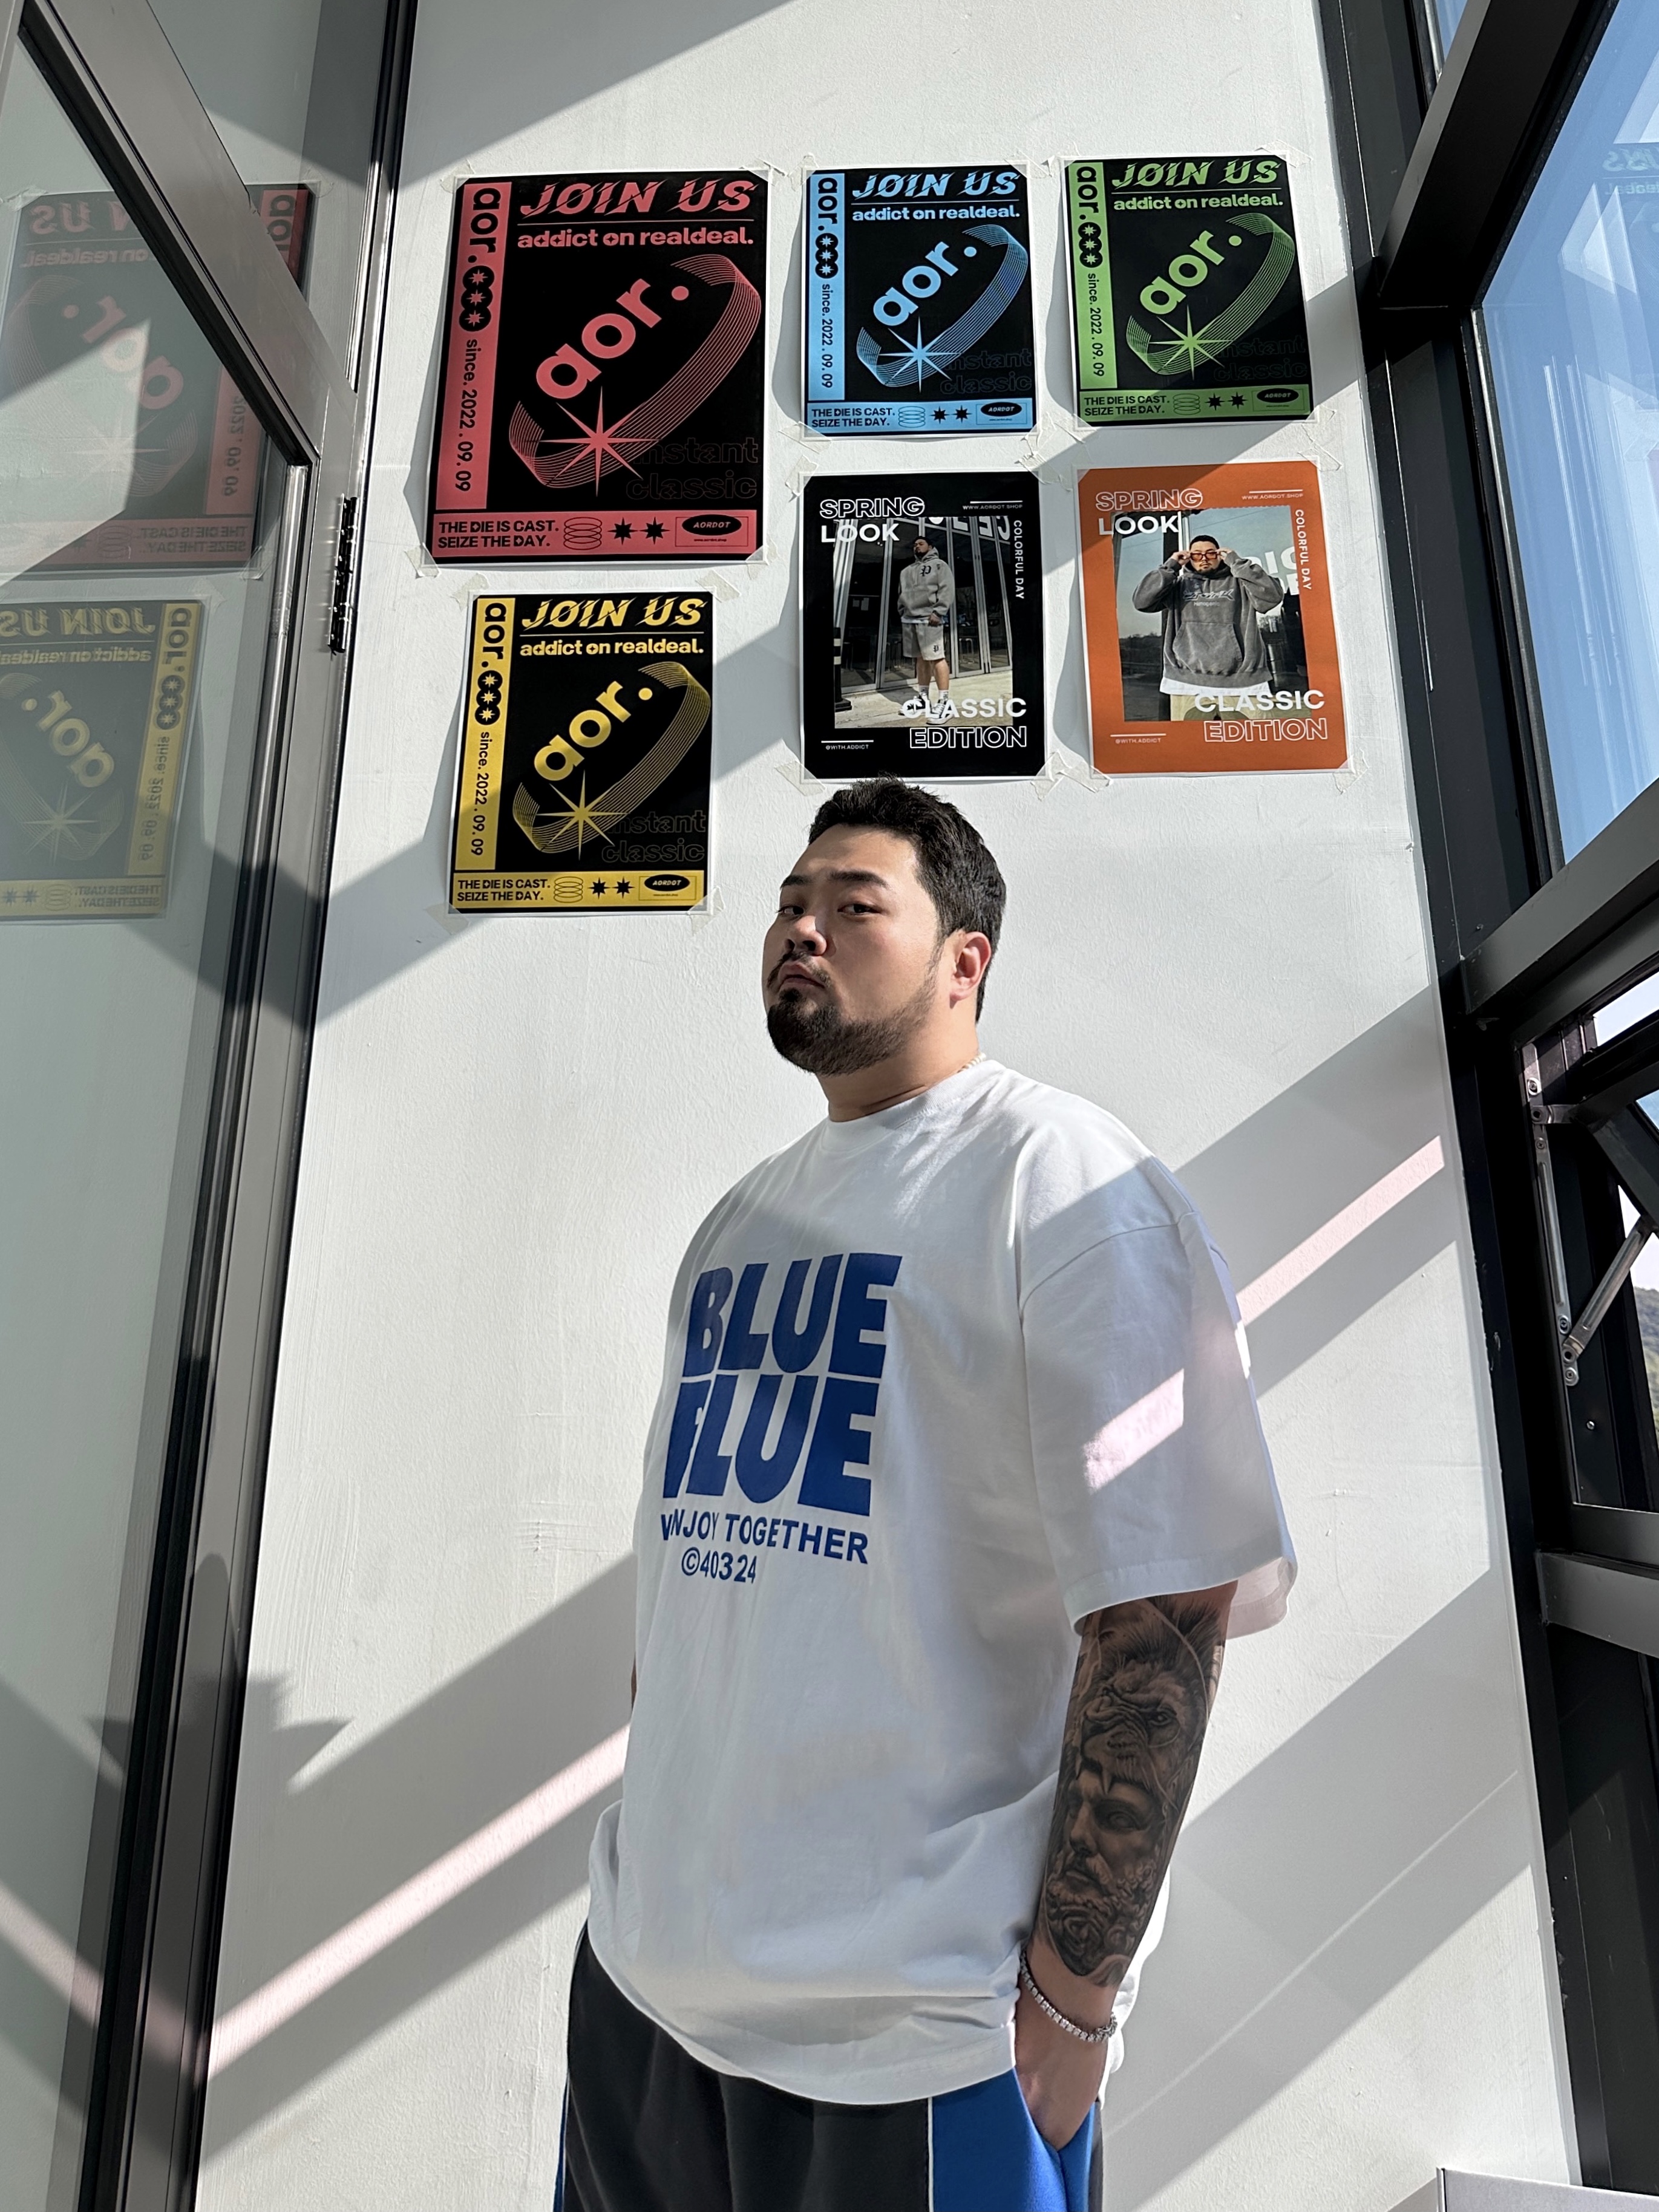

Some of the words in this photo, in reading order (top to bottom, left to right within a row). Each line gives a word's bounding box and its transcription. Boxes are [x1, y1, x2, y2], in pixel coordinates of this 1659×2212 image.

[852, 172, 955, 200] JOIN
[957, 171, 1021, 197] US
[1111, 161, 1214, 189] JOIN
[1217, 159, 1281, 184] US
[520, 178, 666, 218] JOIN
[666, 179, 759, 213] US
[817, 177, 838, 231] aor.
[1076, 166, 1099, 220] aor.
[1114, 196, 1172, 210] addict
[1174, 198, 1197, 209] on
[1202, 193, 1283, 207] realdeal.
[852, 207, 909, 221] addict
[912, 209, 935, 220] on
[939, 205, 1020, 219] realdeal.
[468, 188, 502, 264] aor.
[517, 229, 598, 248] addict
[603, 232, 634, 246] on
[640, 227, 754, 245] realdeal.
[873, 241, 977, 326] aor.
[1140, 230, 1242, 315] aor.
[822, 284, 830, 316] since.
[1088, 273, 1098, 306] since.
[536, 278, 689, 399] aor.
[463, 339, 482, 385] since.
[1084, 397, 1105, 405] THE
[1107, 396, 1124, 405] DIE
[1137, 395, 1170, 403] CAST.
[1084, 406, 1113, 416] SEIZE
[1116, 406, 1136, 414] THE
[1139, 405, 1165, 414] DAY.
[812, 419, 840, 427] SEIZE
[842, 418, 862, 426] THE
[865, 417, 890, 426] DAY.
[633, 437, 759, 465] nstant
[819, 497, 925, 519] SPRING
[1095, 489, 1203, 511] SPRING
[439, 521, 468, 533] THE
[470, 521, 494, 532] DIE
[497, 520, 511, 532] IS
[513, 520, 559, 532] CAST.
[820, 523, 900, 543] LOOK
[1098, 515, 1179, 536] LOOK
[1295, 509, 1309, 565] COLORFUL
[438, 536, 478, 549] SEIZE
[481, 535, 511, 547] THE
[514, 535, 551, 547] DAY.
[1013, 520, 1024, 575] COLORFUL
[1015, 578, 1025, 599] DAY
[1301, 568, 1312, 590] DAY
[522, 597, 638, 631] JOIN
[634, 596, 708, 627] US
[482, 602, 506, 668] aor.
[520, 640, 583, 656] addict
[586, 642, 610, 655] on
[615, 638, 704, 654] realdeal.
[902, 697, 1027, 719] CLASSIC
[1194, 689, 1325, 713] CLASSIC
[534, 680, 653, 781] aor.
[909, 726, 1027, 749] EDITION
[1203, 718, 1328, 743] EDITION
[479, 731, 492, 769] since.
[607, 809, 706, 834] nstant
[457, 879, 480, 889] THE
[483, 879, 501, 889] DIE
[503, 879, 514, 889] IS
[515, 878, 551, 889] CAST.
[457, 892, 488, 901] SEIZE
[491, 891, 513, 901] THE
[515, 890, 544, 901] DAY.
[682, 1252, 903, 1379] BLUE
[725, 1513, 868, 1565] TOGETHER
